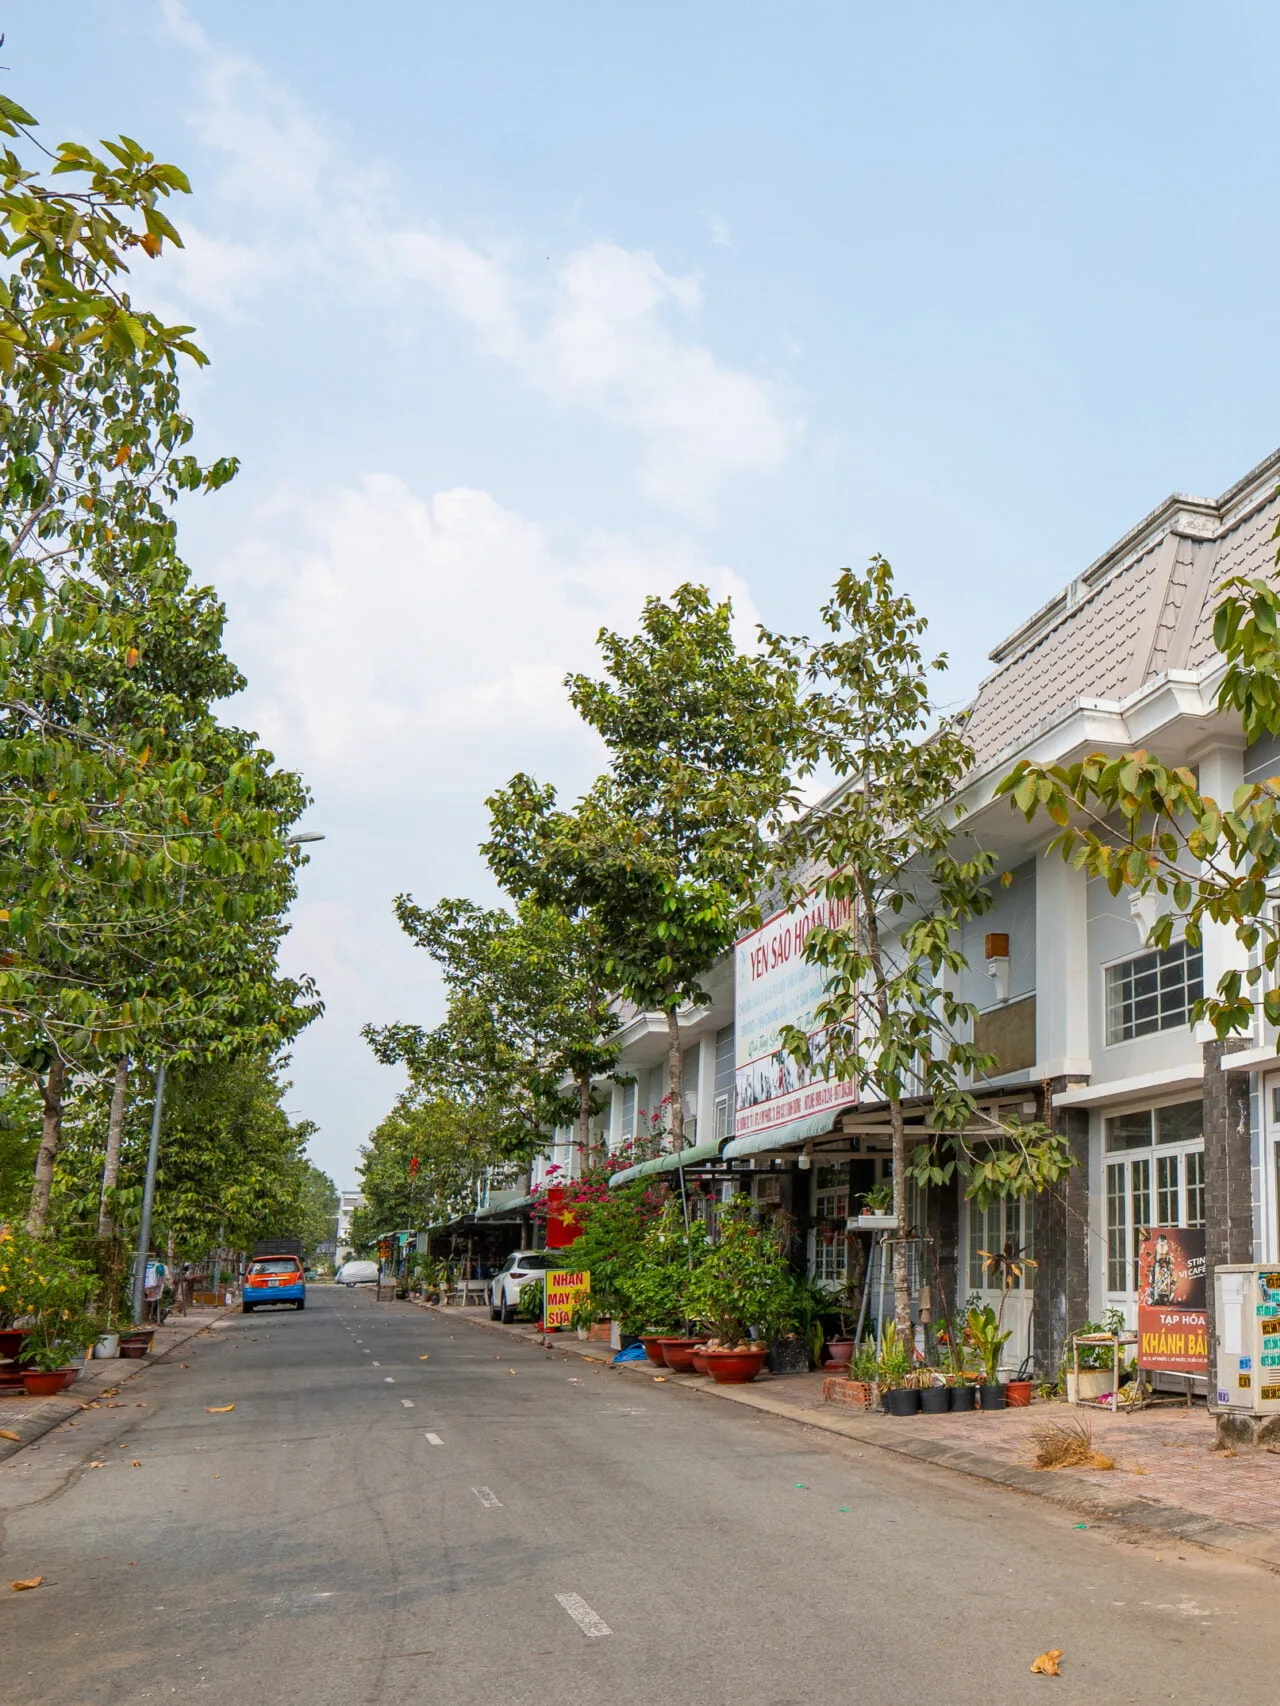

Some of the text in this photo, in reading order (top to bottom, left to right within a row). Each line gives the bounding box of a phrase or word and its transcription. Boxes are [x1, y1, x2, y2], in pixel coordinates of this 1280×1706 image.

[750, 931, 769, 981] YẾN
[771, 922, 791, 970] SÀO
[548, 1292, 570, 1306] MAY
[548, 1307, 570, 1325] SỬA
[1160, 1312, 1206, 1327] TẠP HÓA
[1142, 1327, 1185, 1355] KHÁNH
